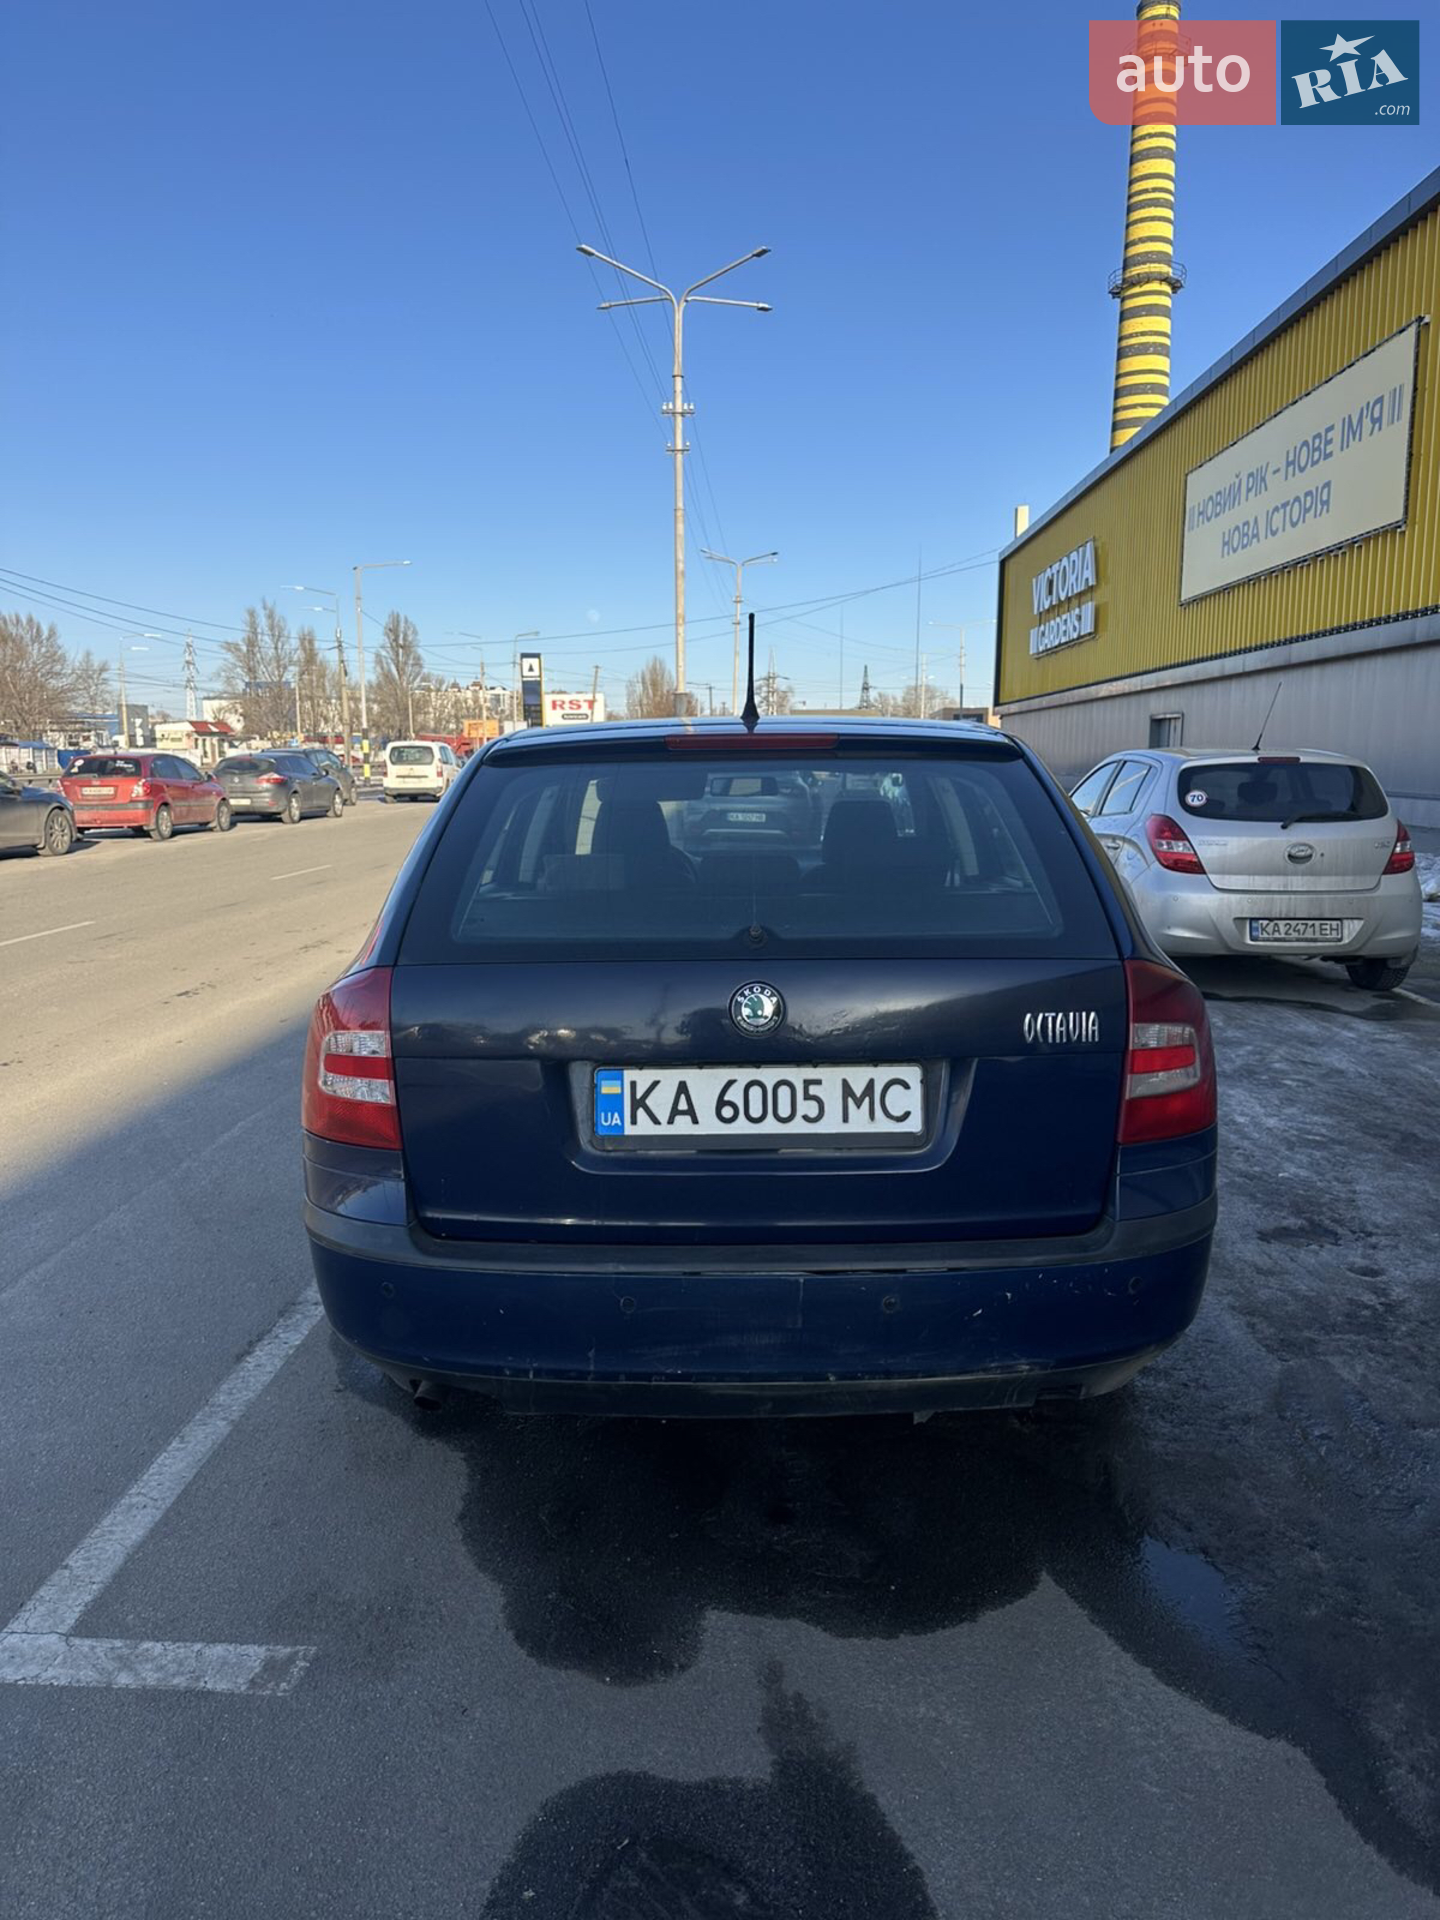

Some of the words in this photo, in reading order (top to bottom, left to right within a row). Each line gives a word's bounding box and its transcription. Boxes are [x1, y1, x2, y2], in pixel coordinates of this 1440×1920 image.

[1196, 471, 1242, 528] НОВИЙ
[1245, 462, 1270, 502] РІК
[1284, 424, 1335, 481] НОВЕ
[1221, 516, 1260, 558] НОВА
[1264, 480, 1332, 539] ІСТОРІЯ
[1032, 540, 1096, 615] VICTORIA
[1038, 607, 1081, 652] GARDENS
[551, 699, 597, 711] RST
[1190, 794, 1204, 803] 70
[1260, 922, 1281, 936] KA
[1284, 922, 1316, 936] 2471
[1319, 922, 1339, 936] EH
[1023, 1011, 1099, 1043] OCTAVIA
[600, 1112, 621, 1126] UA
[629, 1079, 699, 1125] KA
[715, 1078, 825, 1124] 6005
[842, 1077, 911, 1123] MC
